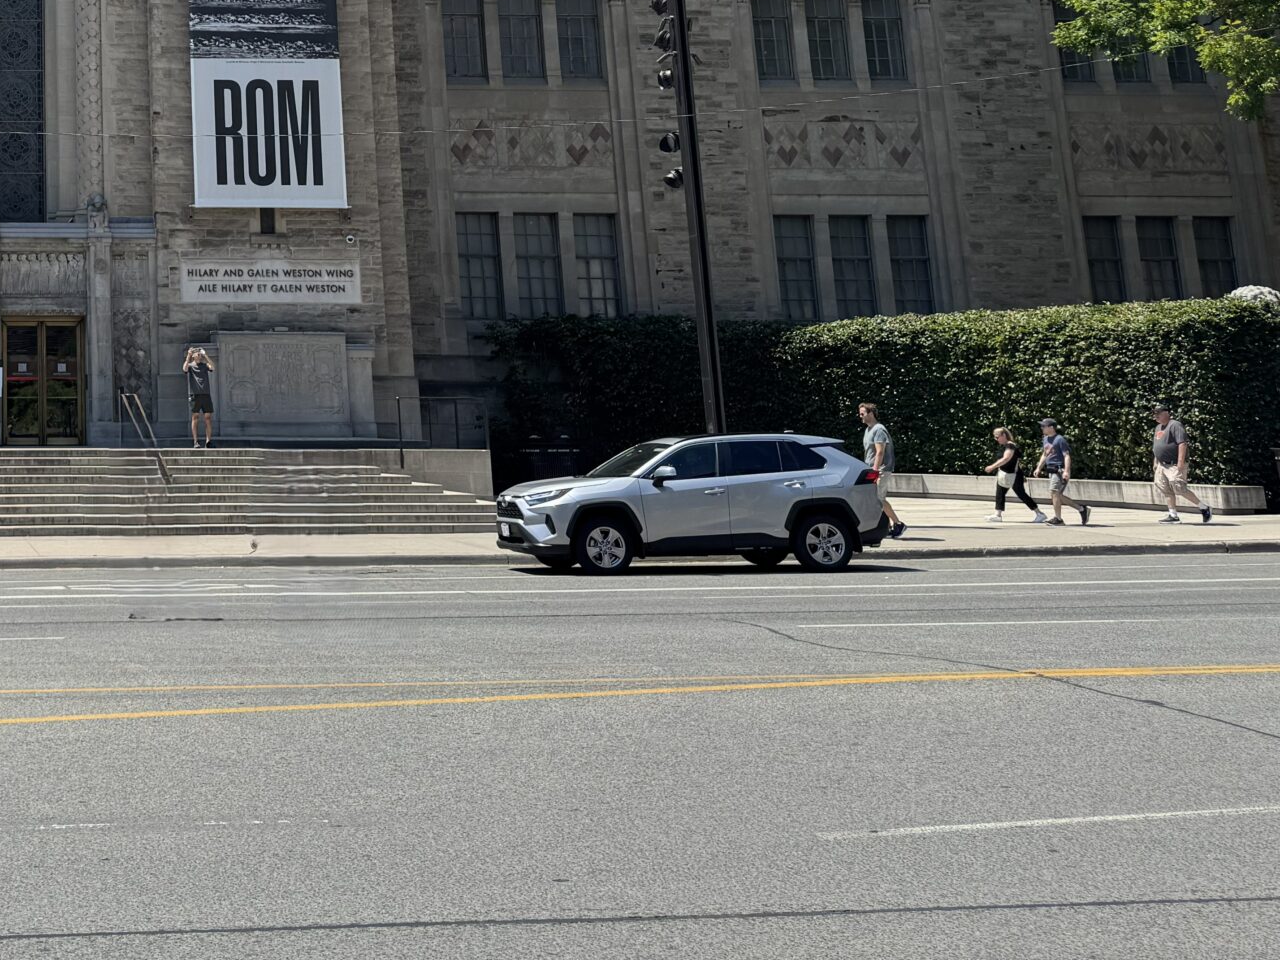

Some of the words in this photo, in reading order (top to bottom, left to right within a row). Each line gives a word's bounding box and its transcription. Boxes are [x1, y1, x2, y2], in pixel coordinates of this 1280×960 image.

[213, 79, 324, 186] ROM
[187, 268, 219, 278] HILARY
[223, 269, 244, 278] AND
[247, 269, 279, 278] GALEN
[282, 269, 322, 278] WESTON
[326, 269, 354, 278] WING
[198, 284, 217, 293] AILE
[221, 284, 253, 293] HILARY
[257, 284, 267, 293] ET
[271, 284, 302, 293] GALEN
[305, 284, 346, 293] WESTON
